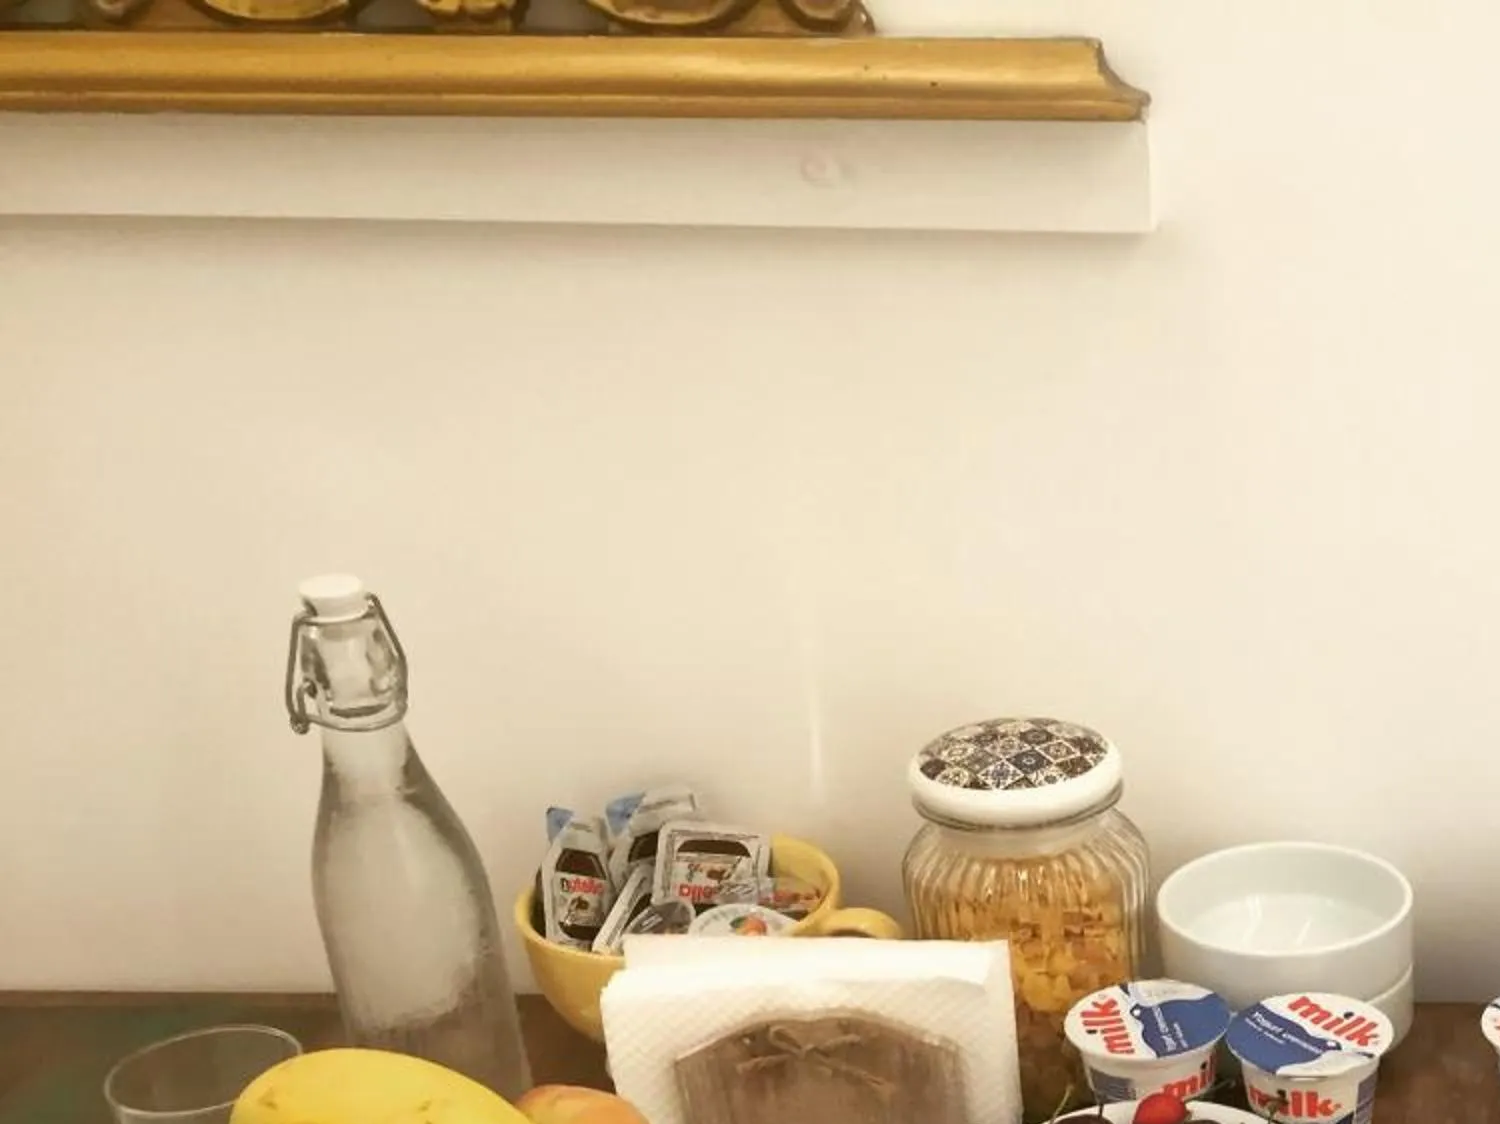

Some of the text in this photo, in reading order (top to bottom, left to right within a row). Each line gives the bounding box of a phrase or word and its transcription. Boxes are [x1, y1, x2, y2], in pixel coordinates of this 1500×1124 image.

[1080, 998, 1135, 1055] milk
[1287, 996, 1380, 1047] milk
[1249, 1086, 1334, 1119] milk
